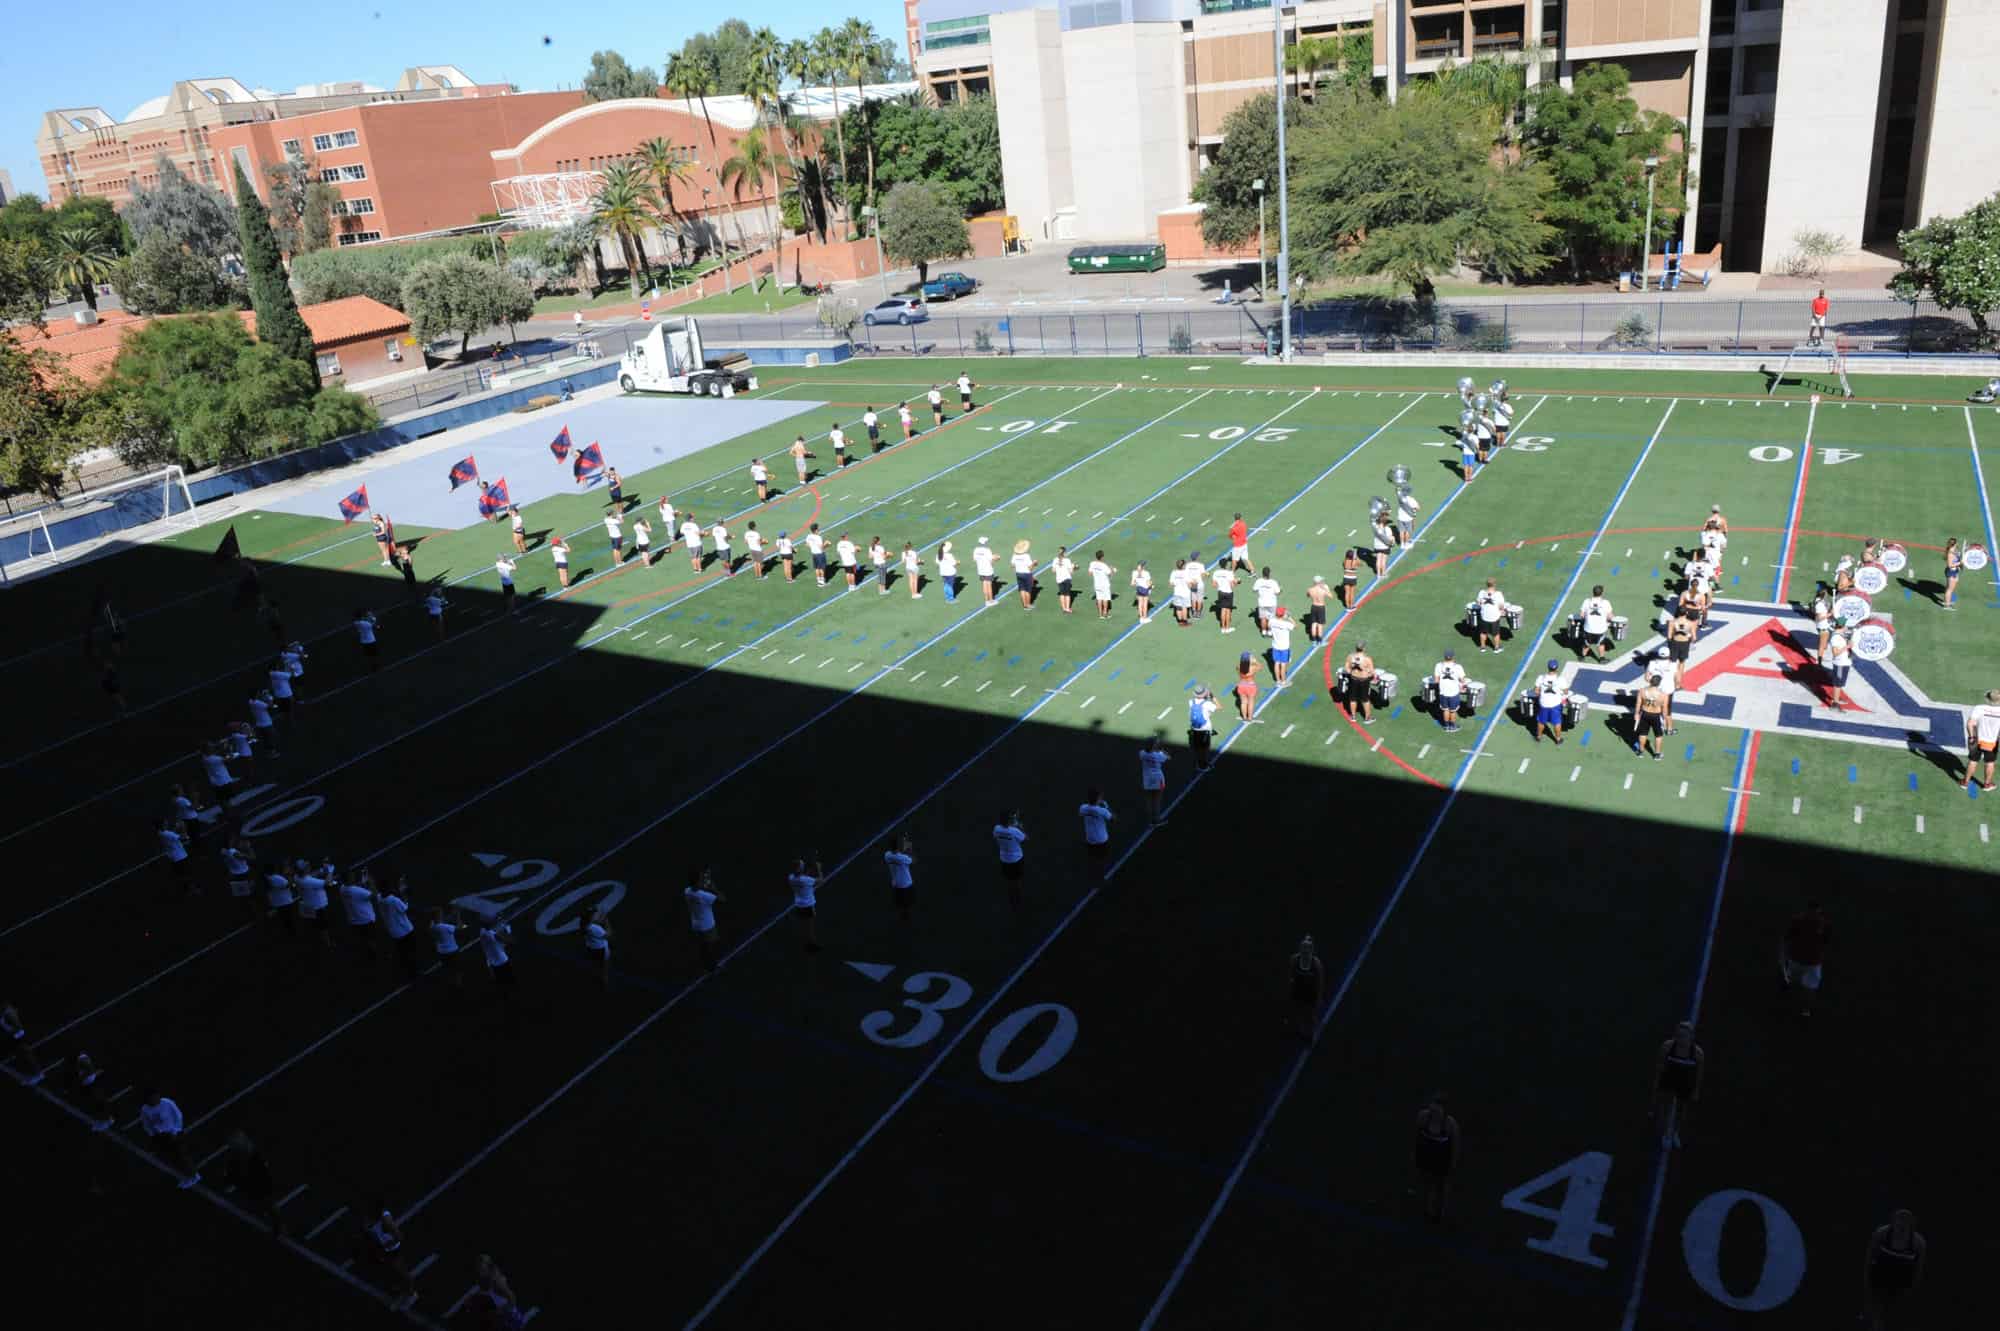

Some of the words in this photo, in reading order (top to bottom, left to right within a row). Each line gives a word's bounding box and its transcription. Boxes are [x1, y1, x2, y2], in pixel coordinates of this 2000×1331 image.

[999, 420, 1079, 433] 10
[1208, 426, 1299, 442] 20
[1748, 445, 1864, 465] 40
[448, 858, 627, 936] 20
[859, 970, 1079, 1084] 30
[1501, 1150, 1808, 1312] 40
